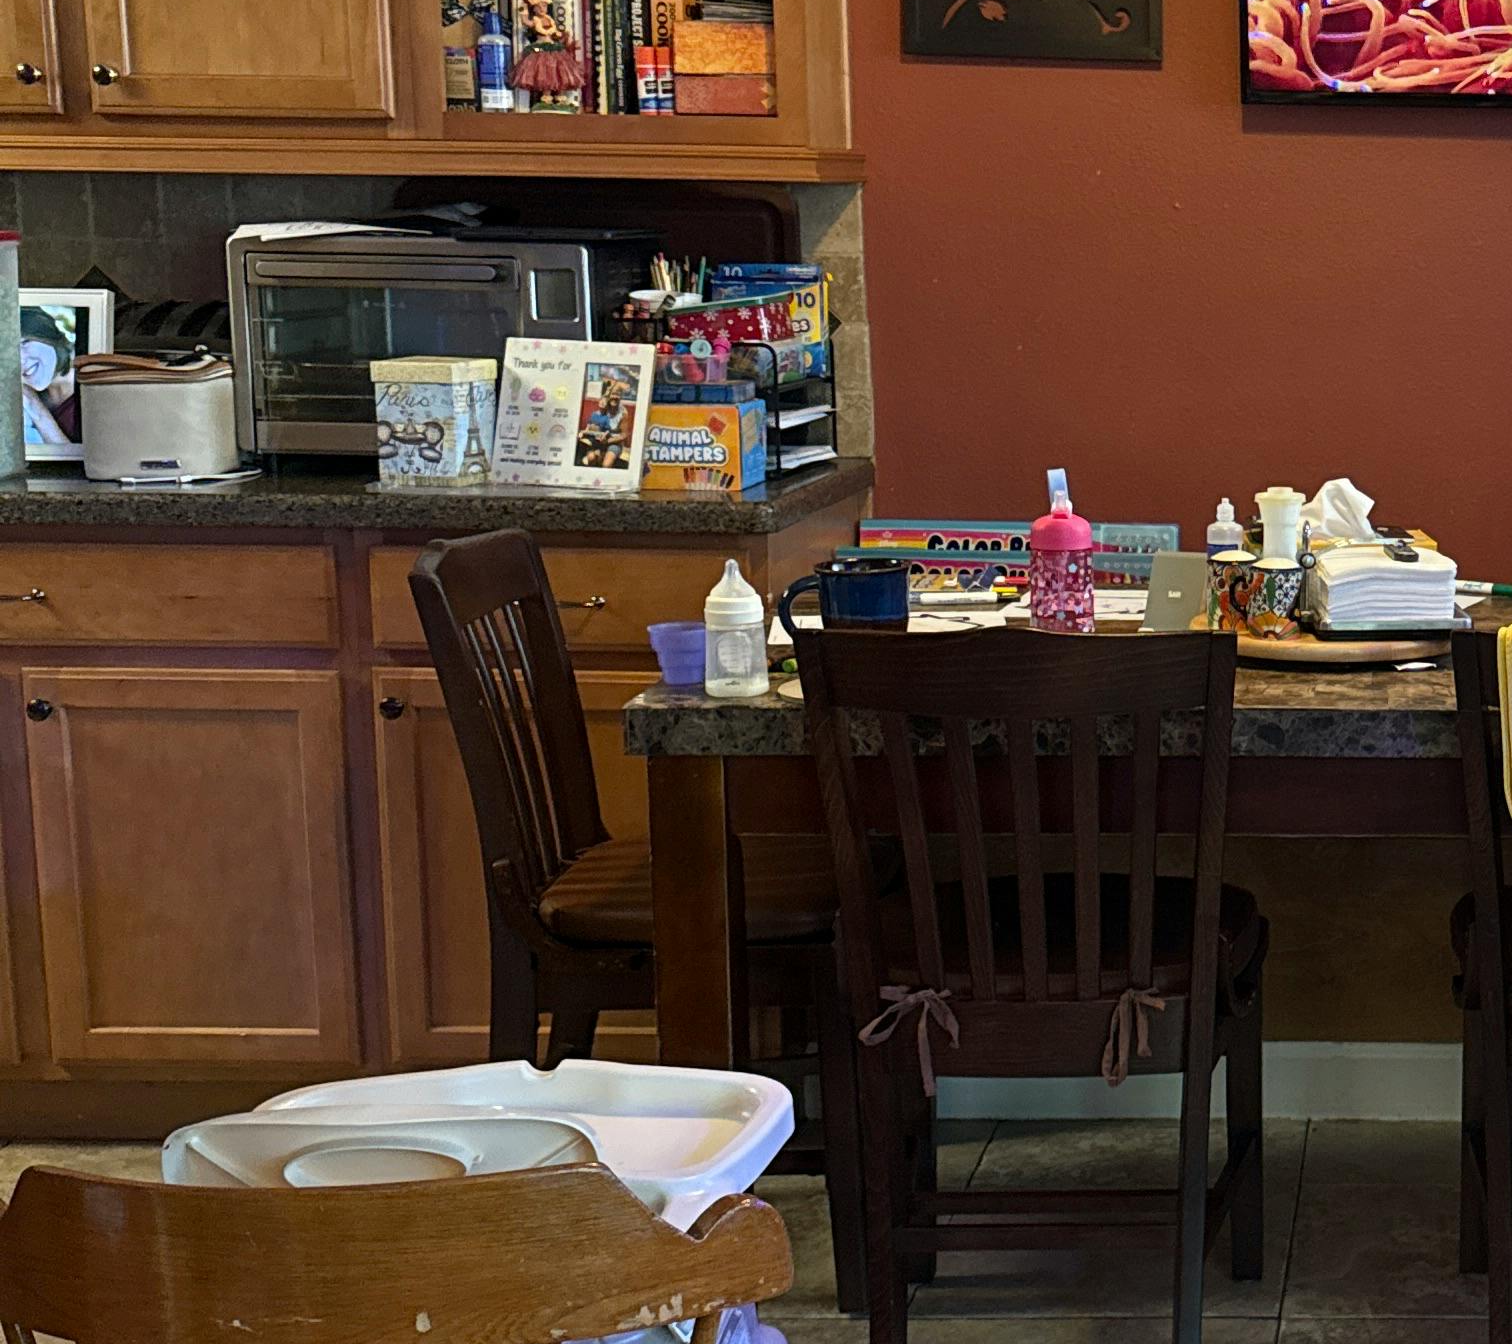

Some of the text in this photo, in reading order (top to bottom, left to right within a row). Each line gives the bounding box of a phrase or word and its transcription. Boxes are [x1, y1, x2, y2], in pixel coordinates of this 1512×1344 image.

[656, 1, 670, 48] COOK
[795, 291, 816, 308] 10
[791, 318, 811, 334] es
[513, 357, 538, 369] Thank
[541, 361, 555, 372] you
[649, 427, 712, 445] ANIMAL
